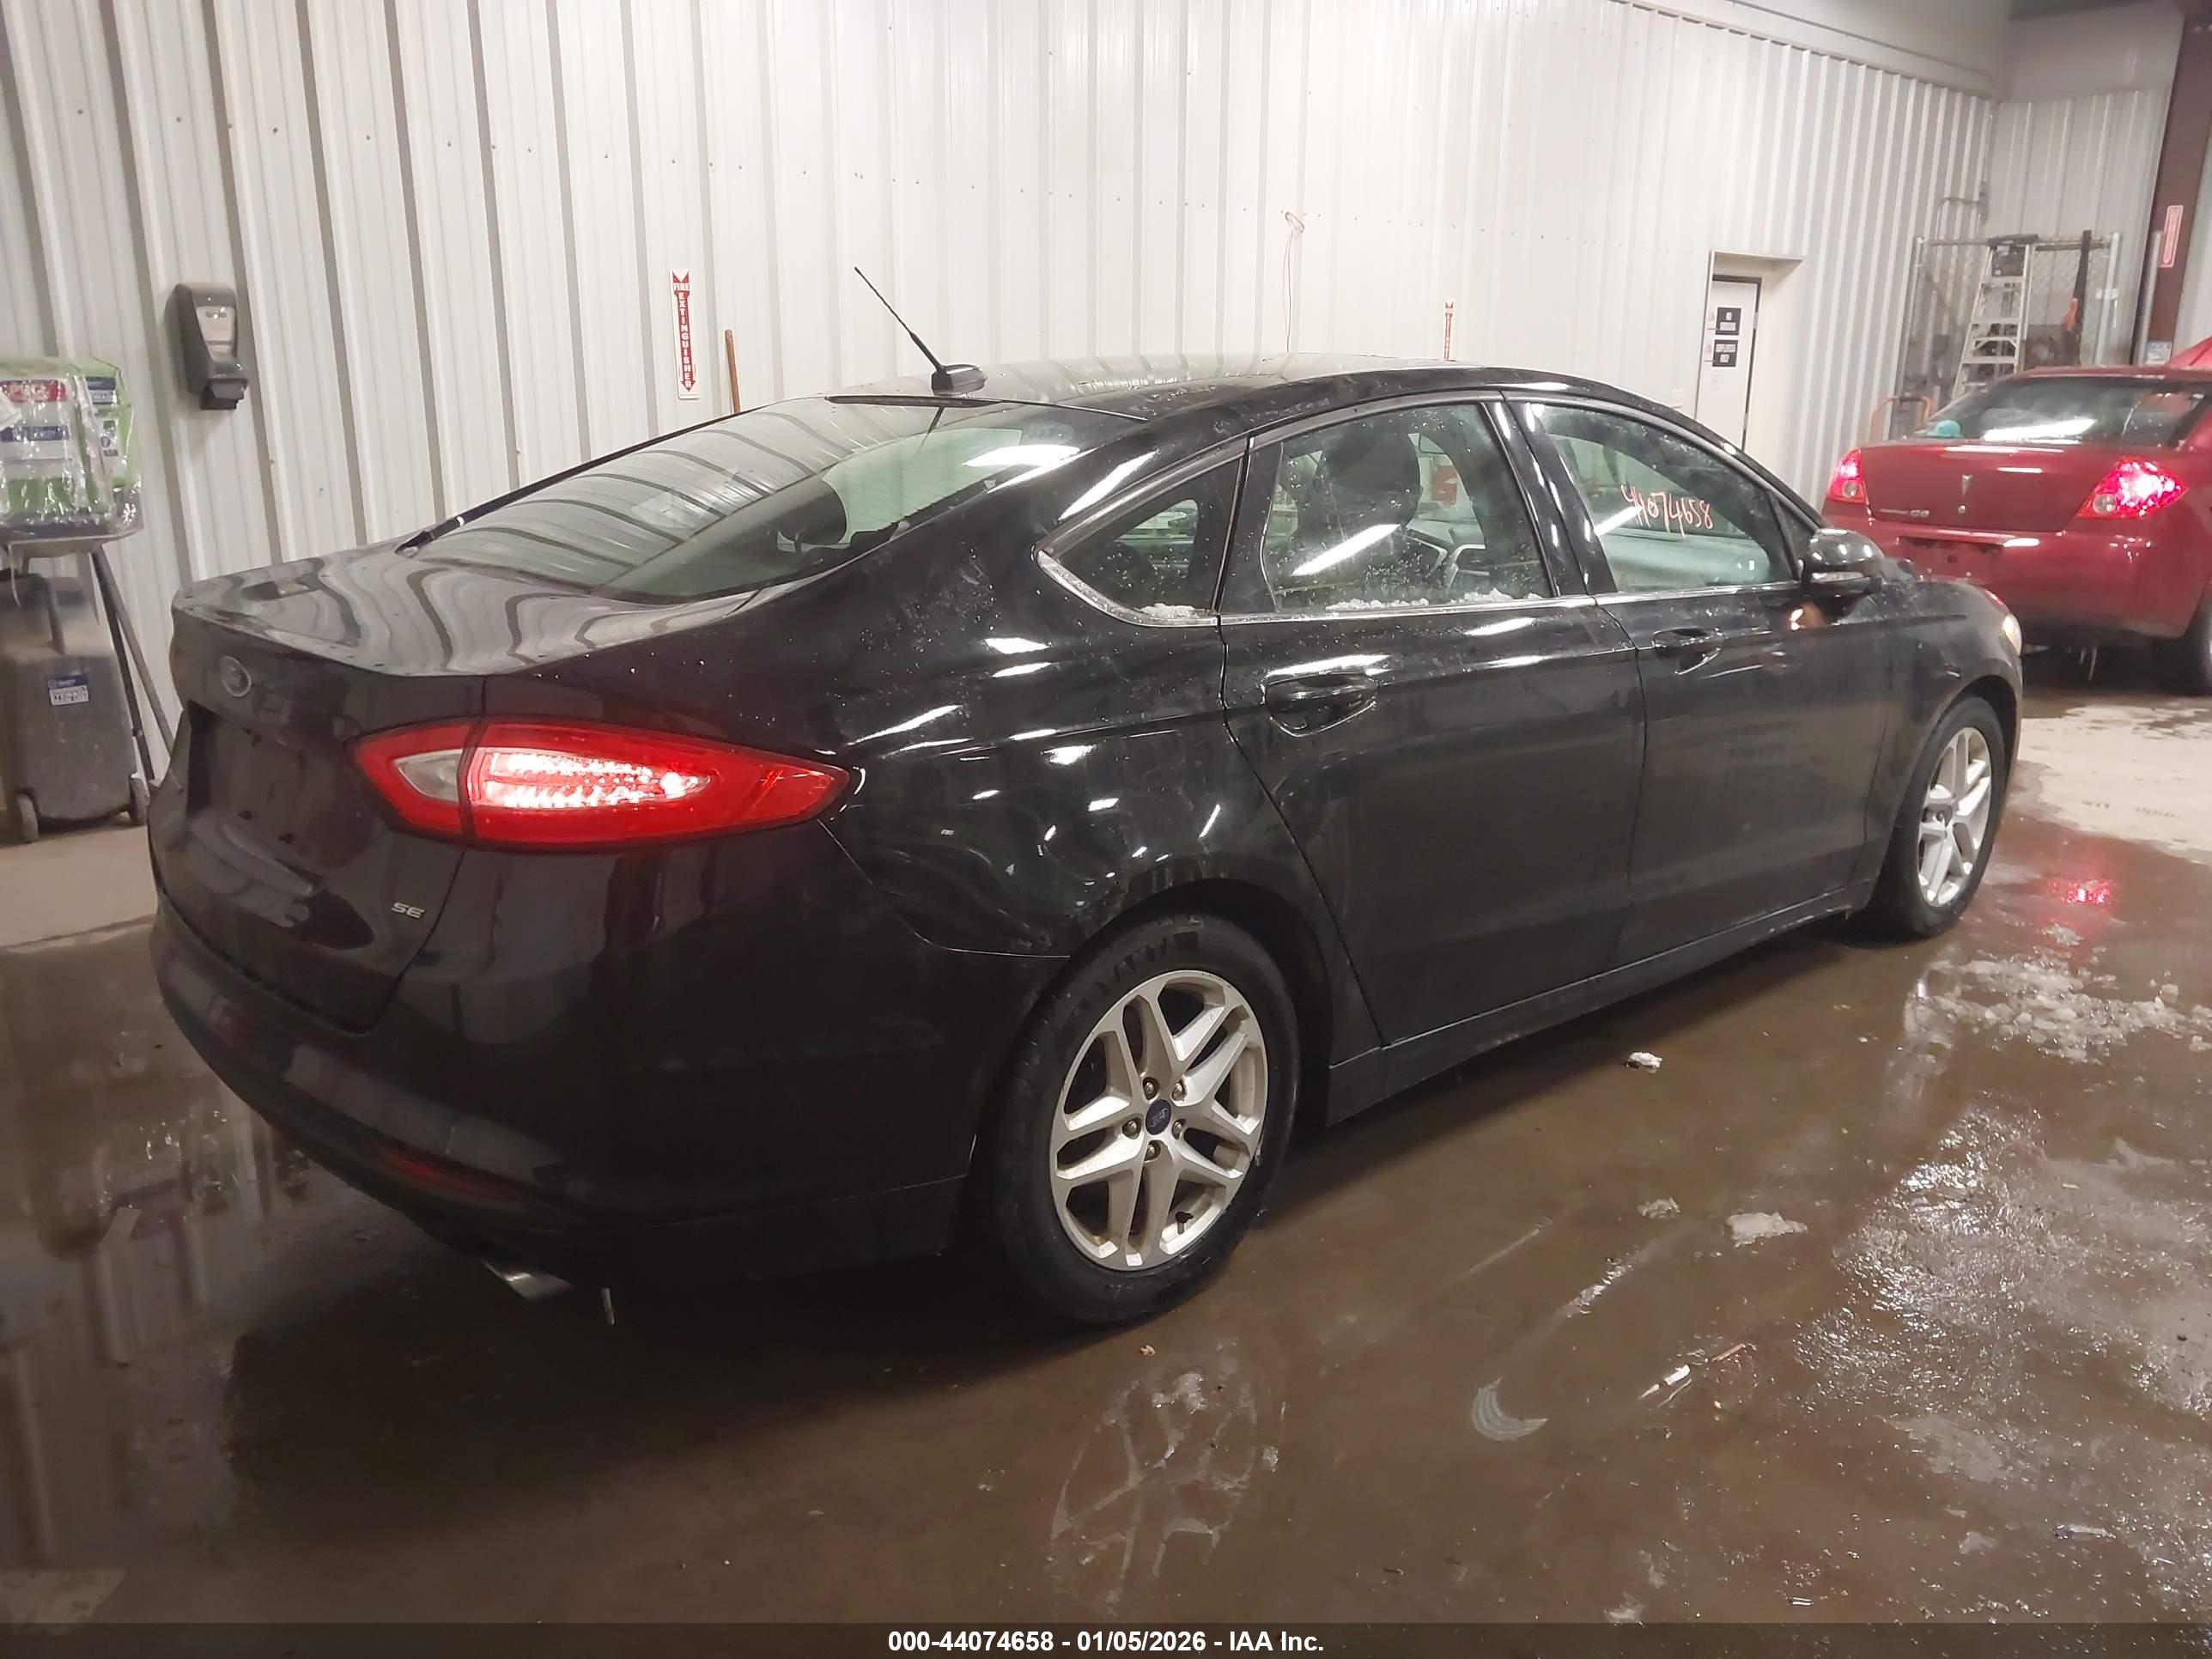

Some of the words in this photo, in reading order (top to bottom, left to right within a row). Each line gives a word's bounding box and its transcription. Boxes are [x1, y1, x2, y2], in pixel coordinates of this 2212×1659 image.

[672, 283, 690, 291] FIRE
[678, 292, 692, 388] EXTINGUISHER
[1620, 483, 1714, 538] 44074658
[391, 902, 426, 919] SE
